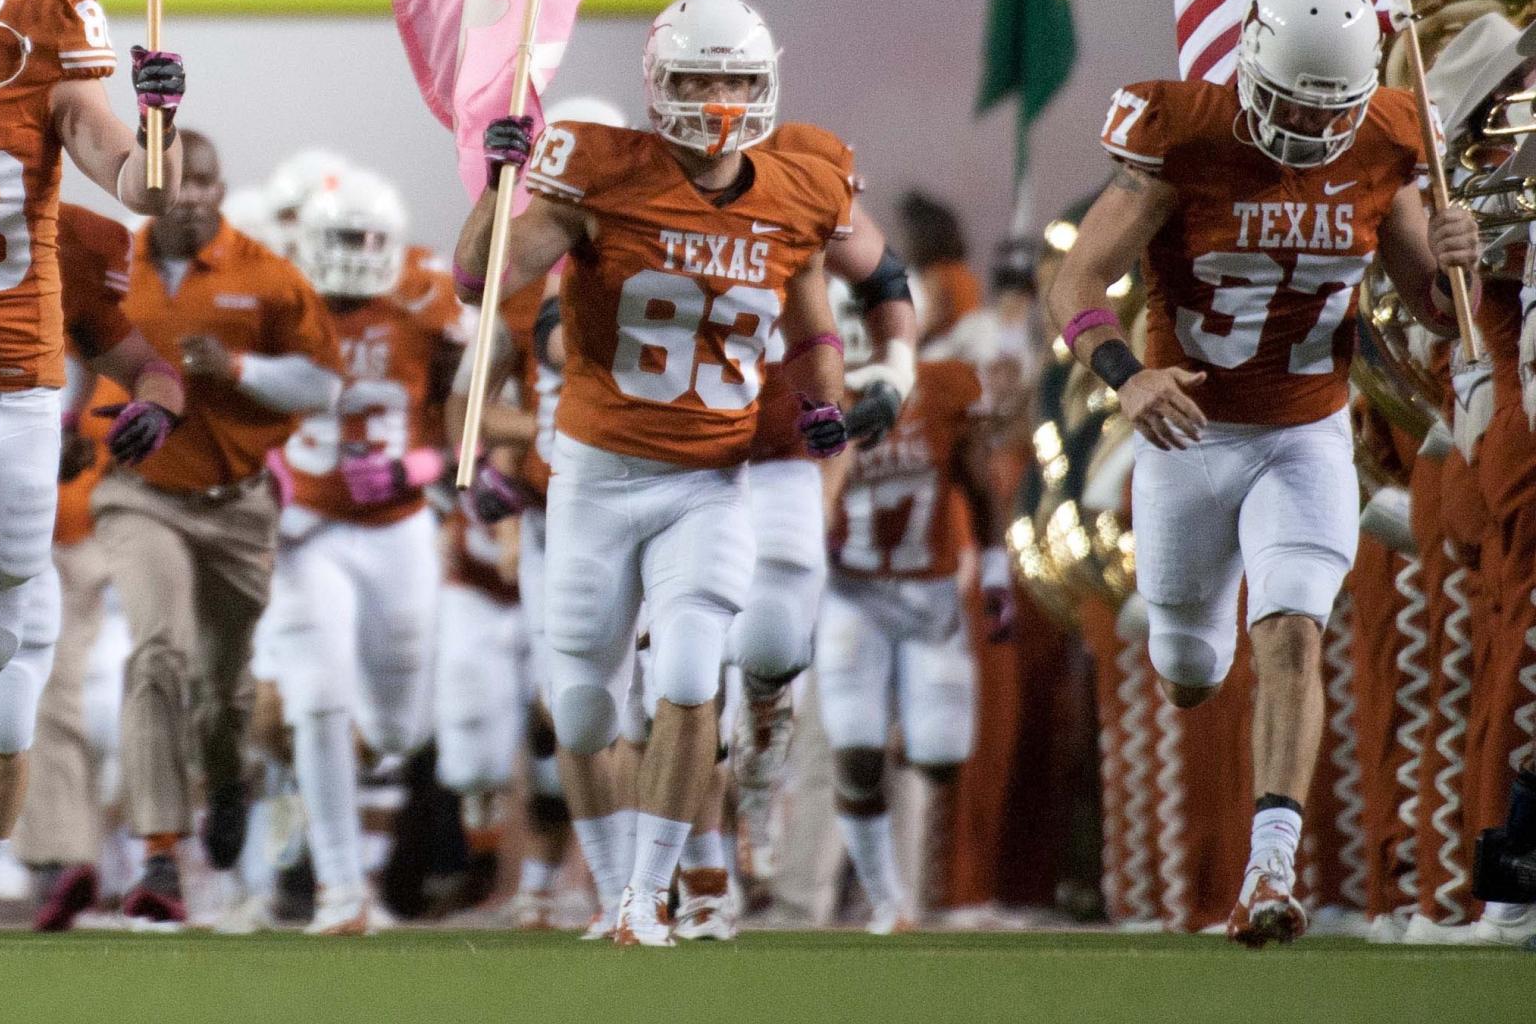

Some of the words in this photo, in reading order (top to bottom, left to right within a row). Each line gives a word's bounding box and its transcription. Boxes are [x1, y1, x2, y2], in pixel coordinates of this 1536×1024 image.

[75, 0, 112, 49] 8
[659, 229, 769, 284] TEXAS
[1233, 201, 1354, 250] TEXAS
[611, 269, 781, 411] 83
[1175, 250, 1376, 376] 37
[839, 473, 938, 569] 17
